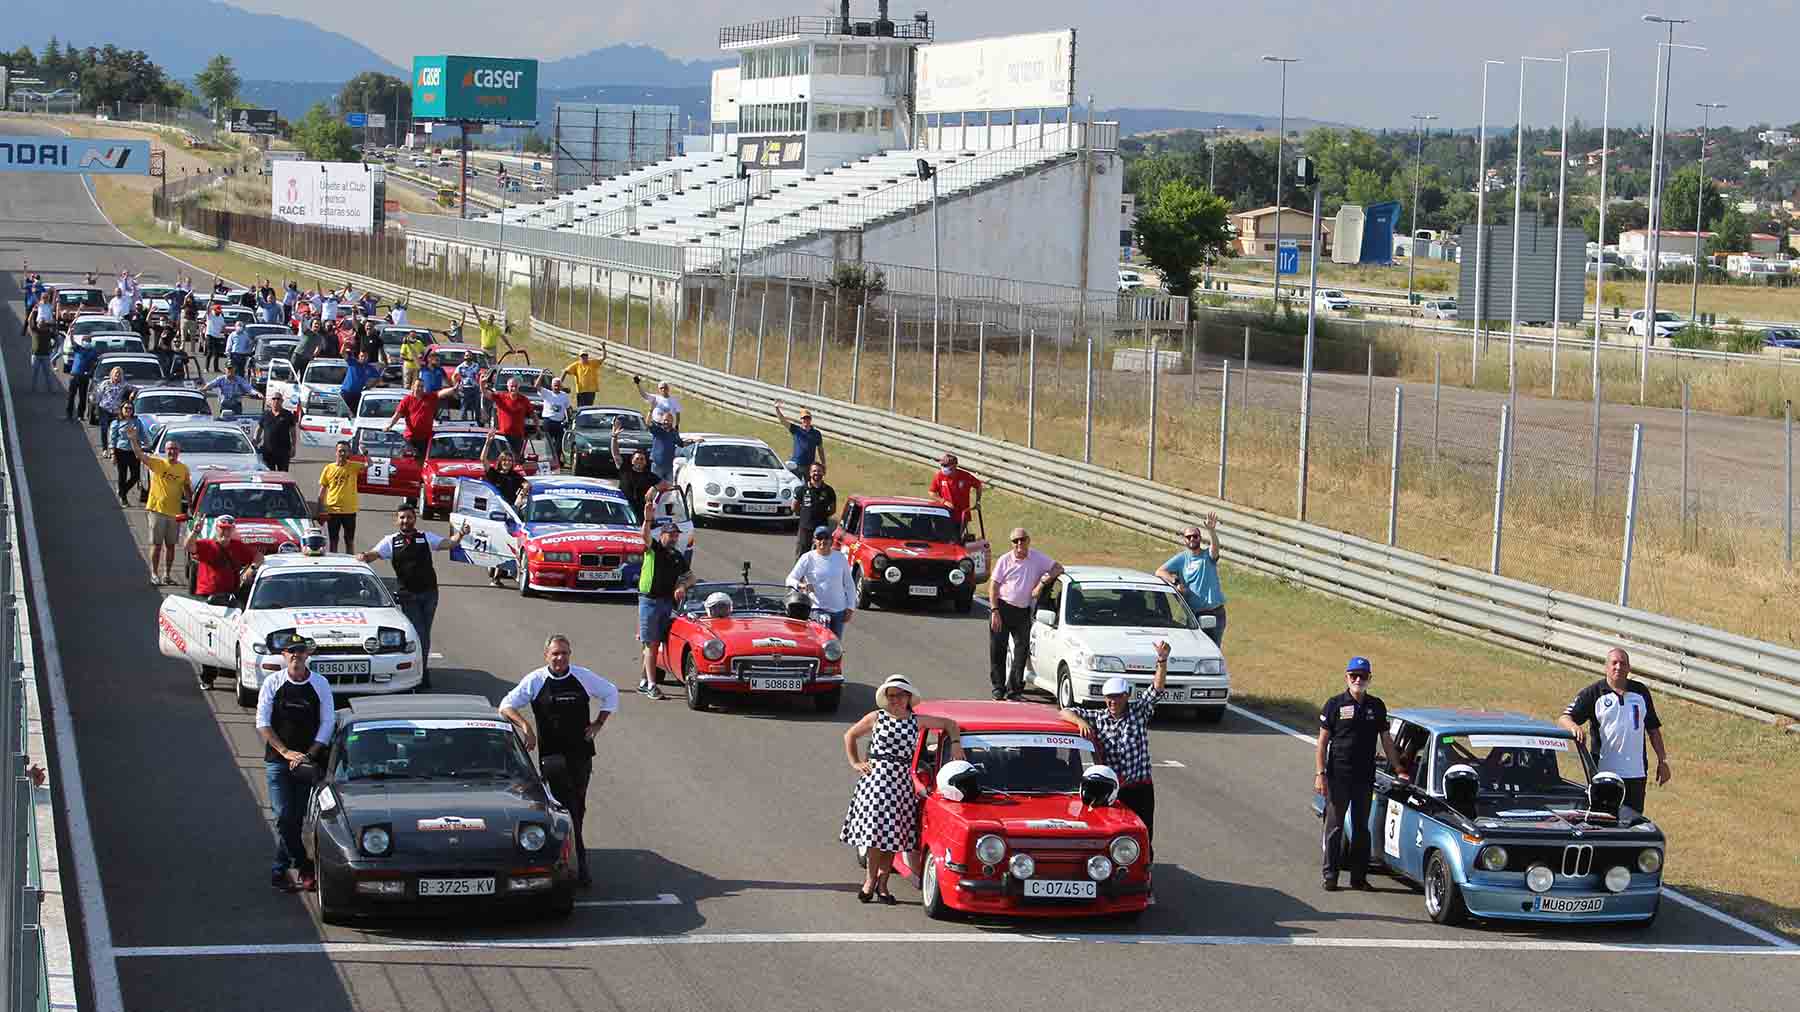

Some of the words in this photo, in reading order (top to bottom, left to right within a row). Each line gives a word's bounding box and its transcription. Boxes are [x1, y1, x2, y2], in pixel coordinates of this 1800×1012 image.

[474, 68, 523, 88] caser
[279, 206, 305, 216] RACE
[374, 465, 382, 477] 5
[474, 538, 487, 553] 21
[1046, 737, 1075, 745] BOSCH
[1542, 899, 1602, 912] MU8079AD
